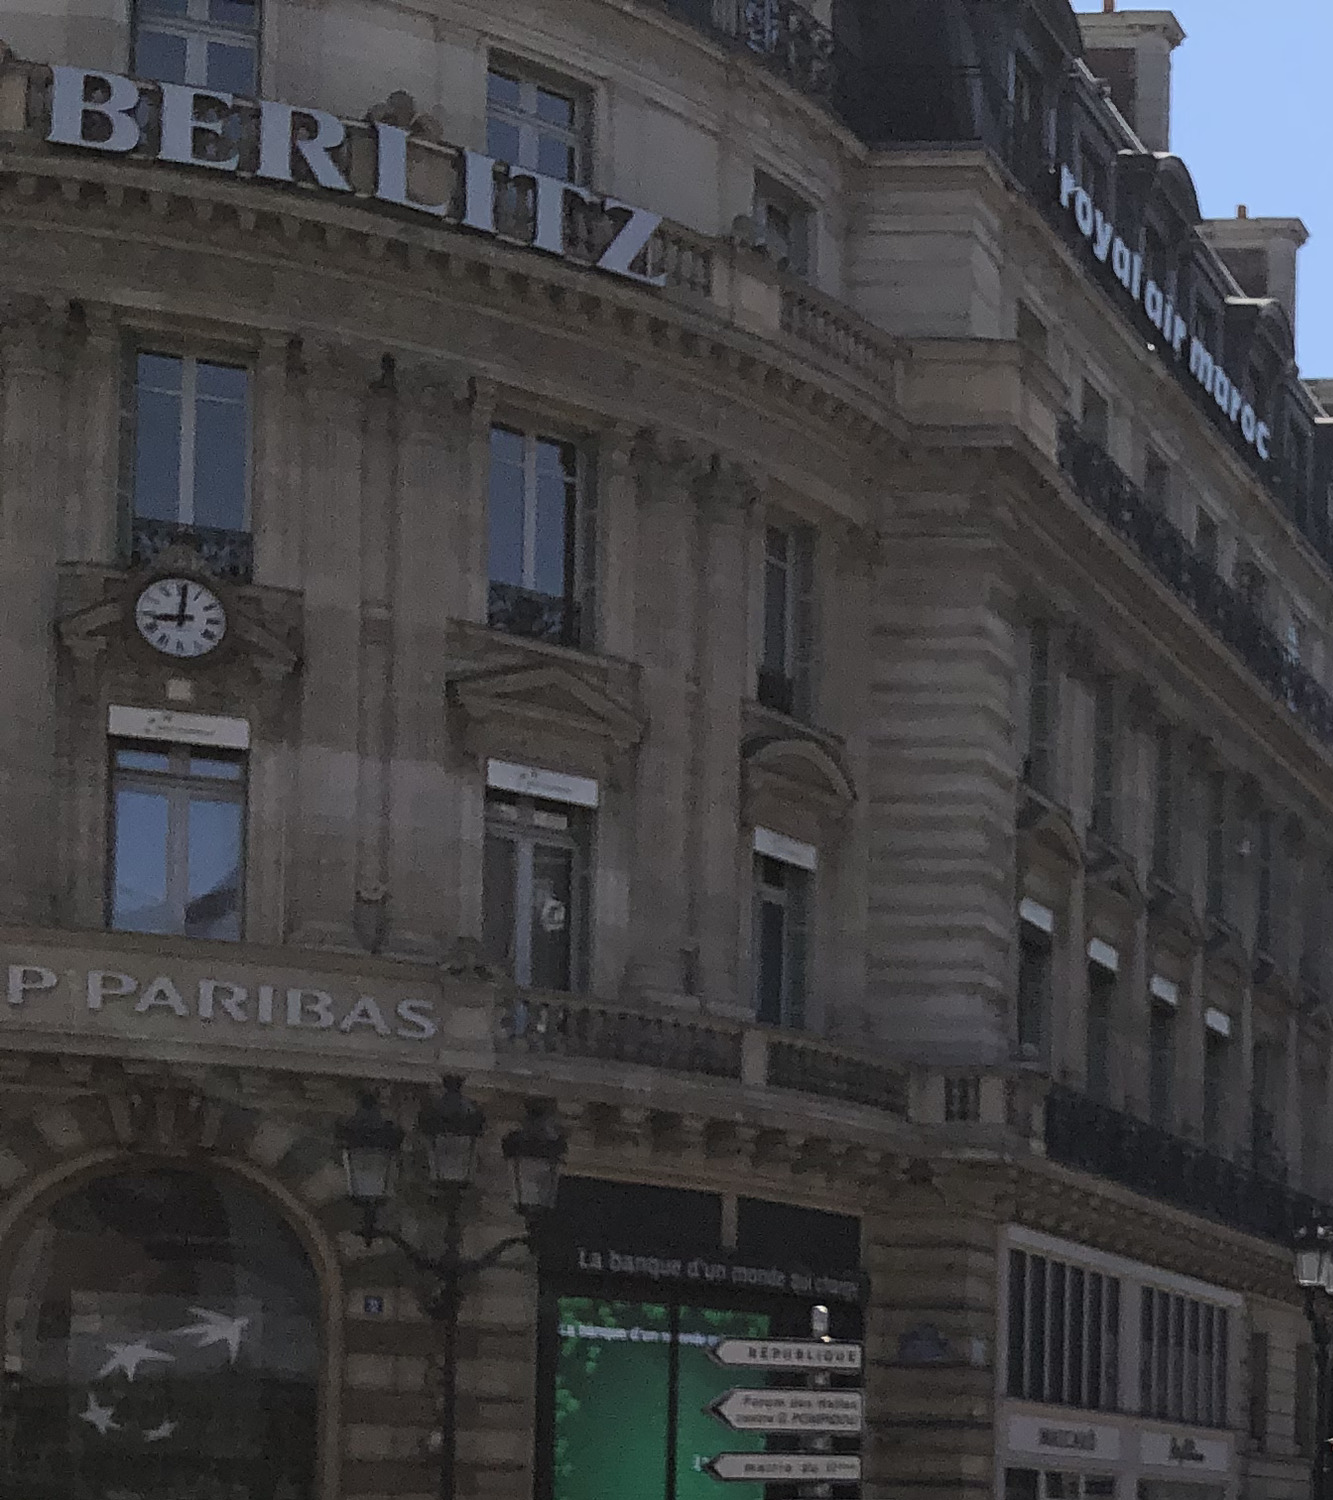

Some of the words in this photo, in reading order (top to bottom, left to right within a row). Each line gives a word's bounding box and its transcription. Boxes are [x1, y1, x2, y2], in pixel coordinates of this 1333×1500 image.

[45, 64, 667, 288] BERLITZ
[1060, 163, 1143, 302] royal
[1144, 279, 1187, 358] air
[1189, 336, 1271, 461] maroc
[87, 969, 440, 1040] PARIBAS
[579, 1248, 602, 1270] La
[608, 1250, 683, 1281] banque
